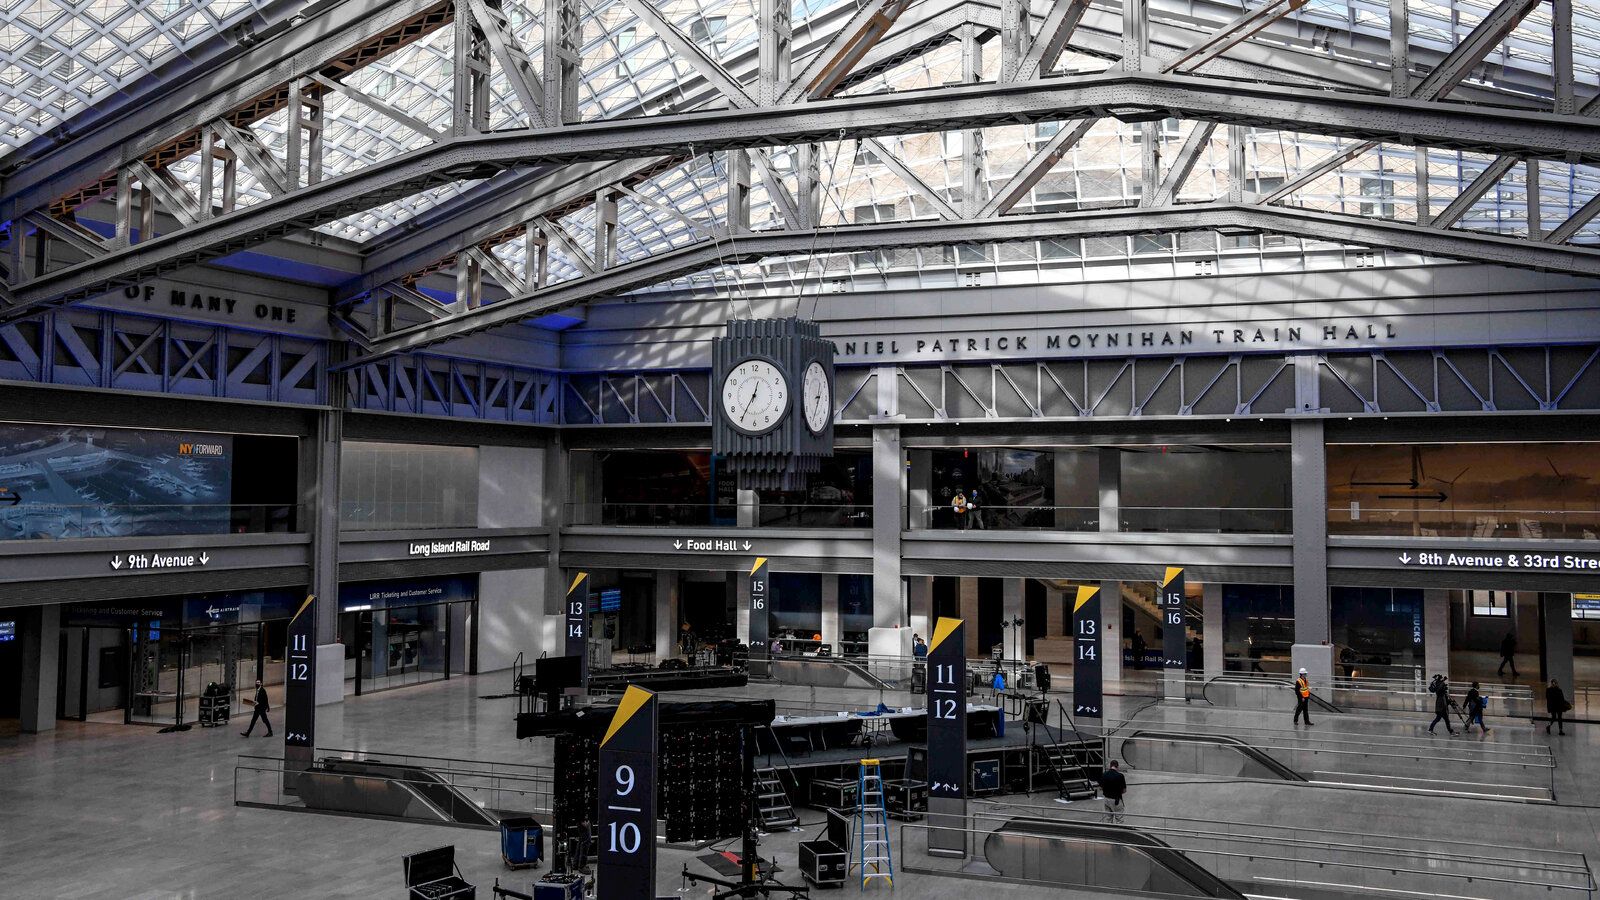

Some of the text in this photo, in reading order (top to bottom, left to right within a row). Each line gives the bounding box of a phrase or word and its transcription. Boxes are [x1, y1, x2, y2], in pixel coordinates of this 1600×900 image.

[125, 285, 296, 323] OF MANY ONE
[833, 324, 1396, 356] ANIEL PATRICK MOYNIHAN TRAIN HALL
[752, 364, 759, 372] 12
[179, 443, 223, 455] NY FORWARD
[409, 539, 490, 557] Long Island Rail Road
[687, 539, 737, 551] Food Hall
[128, 553, 194, 569] 9th Avenue
[1419, 552, 1600, 569] 8th Avenue & 33rd Stre
[381, 591, 400, 599] Ticketing
[408, 589, 427, 597] Customer
[427, 587, 442, 595] Service
[752, 581, 764, 592] 15
[753, 598, 764, 610] 16
[1167, 593, 1180, 605] 15
[141, 608, 163, 617] Service
[570, 602, 583, 615] 13
[1168, 612, 1181, 625] 16
[569, 624, 583, 638] 14
[1080, 619, 1096, 635] 13
[293, 634, 306, 651] 11
[1078, 645, 1096, 661] 14
[291, 663, 308, 680] 12
[936, 664, 955, 685] 11
[934, 699, 957, 720] 12
[615, 764, 635, 796] 9
[607, 821, 641, 854] 10
